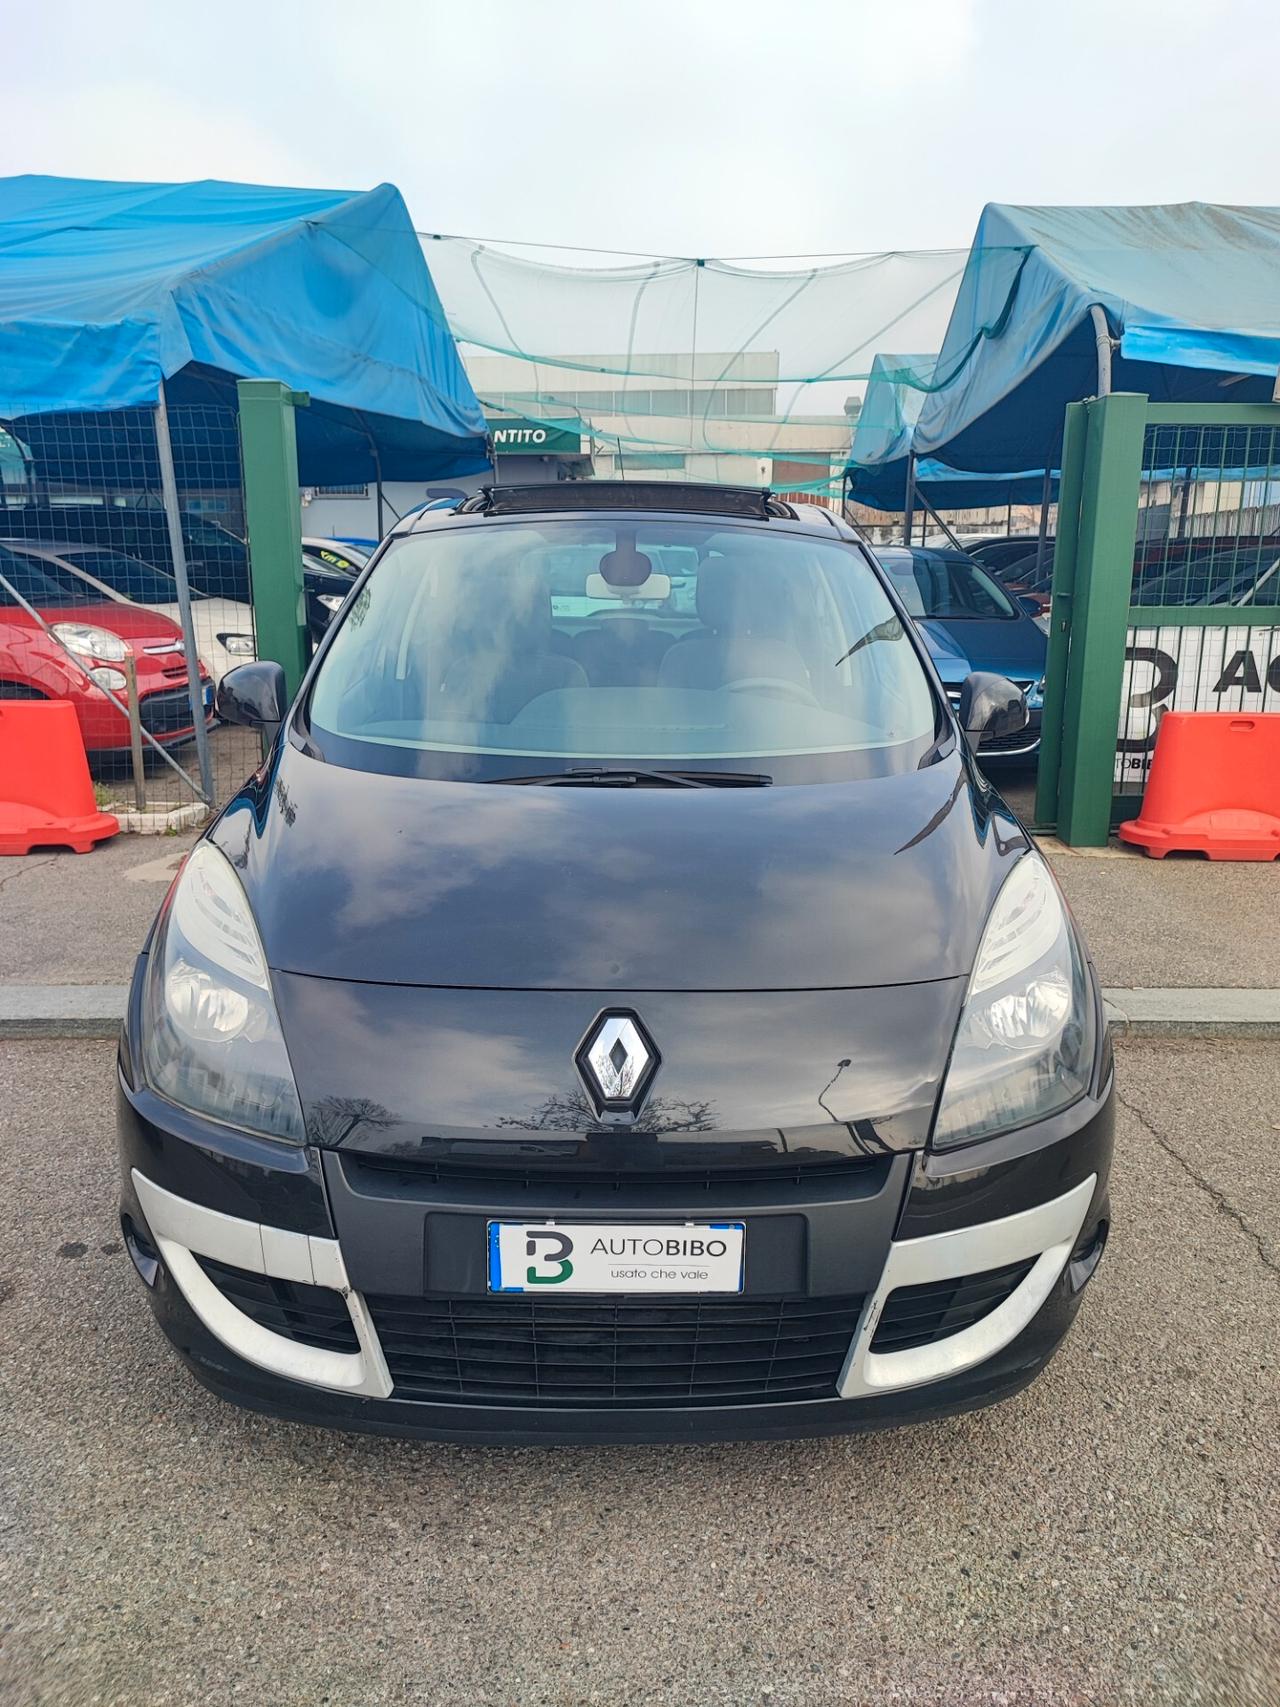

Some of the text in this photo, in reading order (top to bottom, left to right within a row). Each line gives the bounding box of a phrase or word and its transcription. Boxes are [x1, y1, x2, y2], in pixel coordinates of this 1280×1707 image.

[590, 1238, 727, 1257] AUTOBIBO
[611, 1268, 709, 1280] usato che vale
